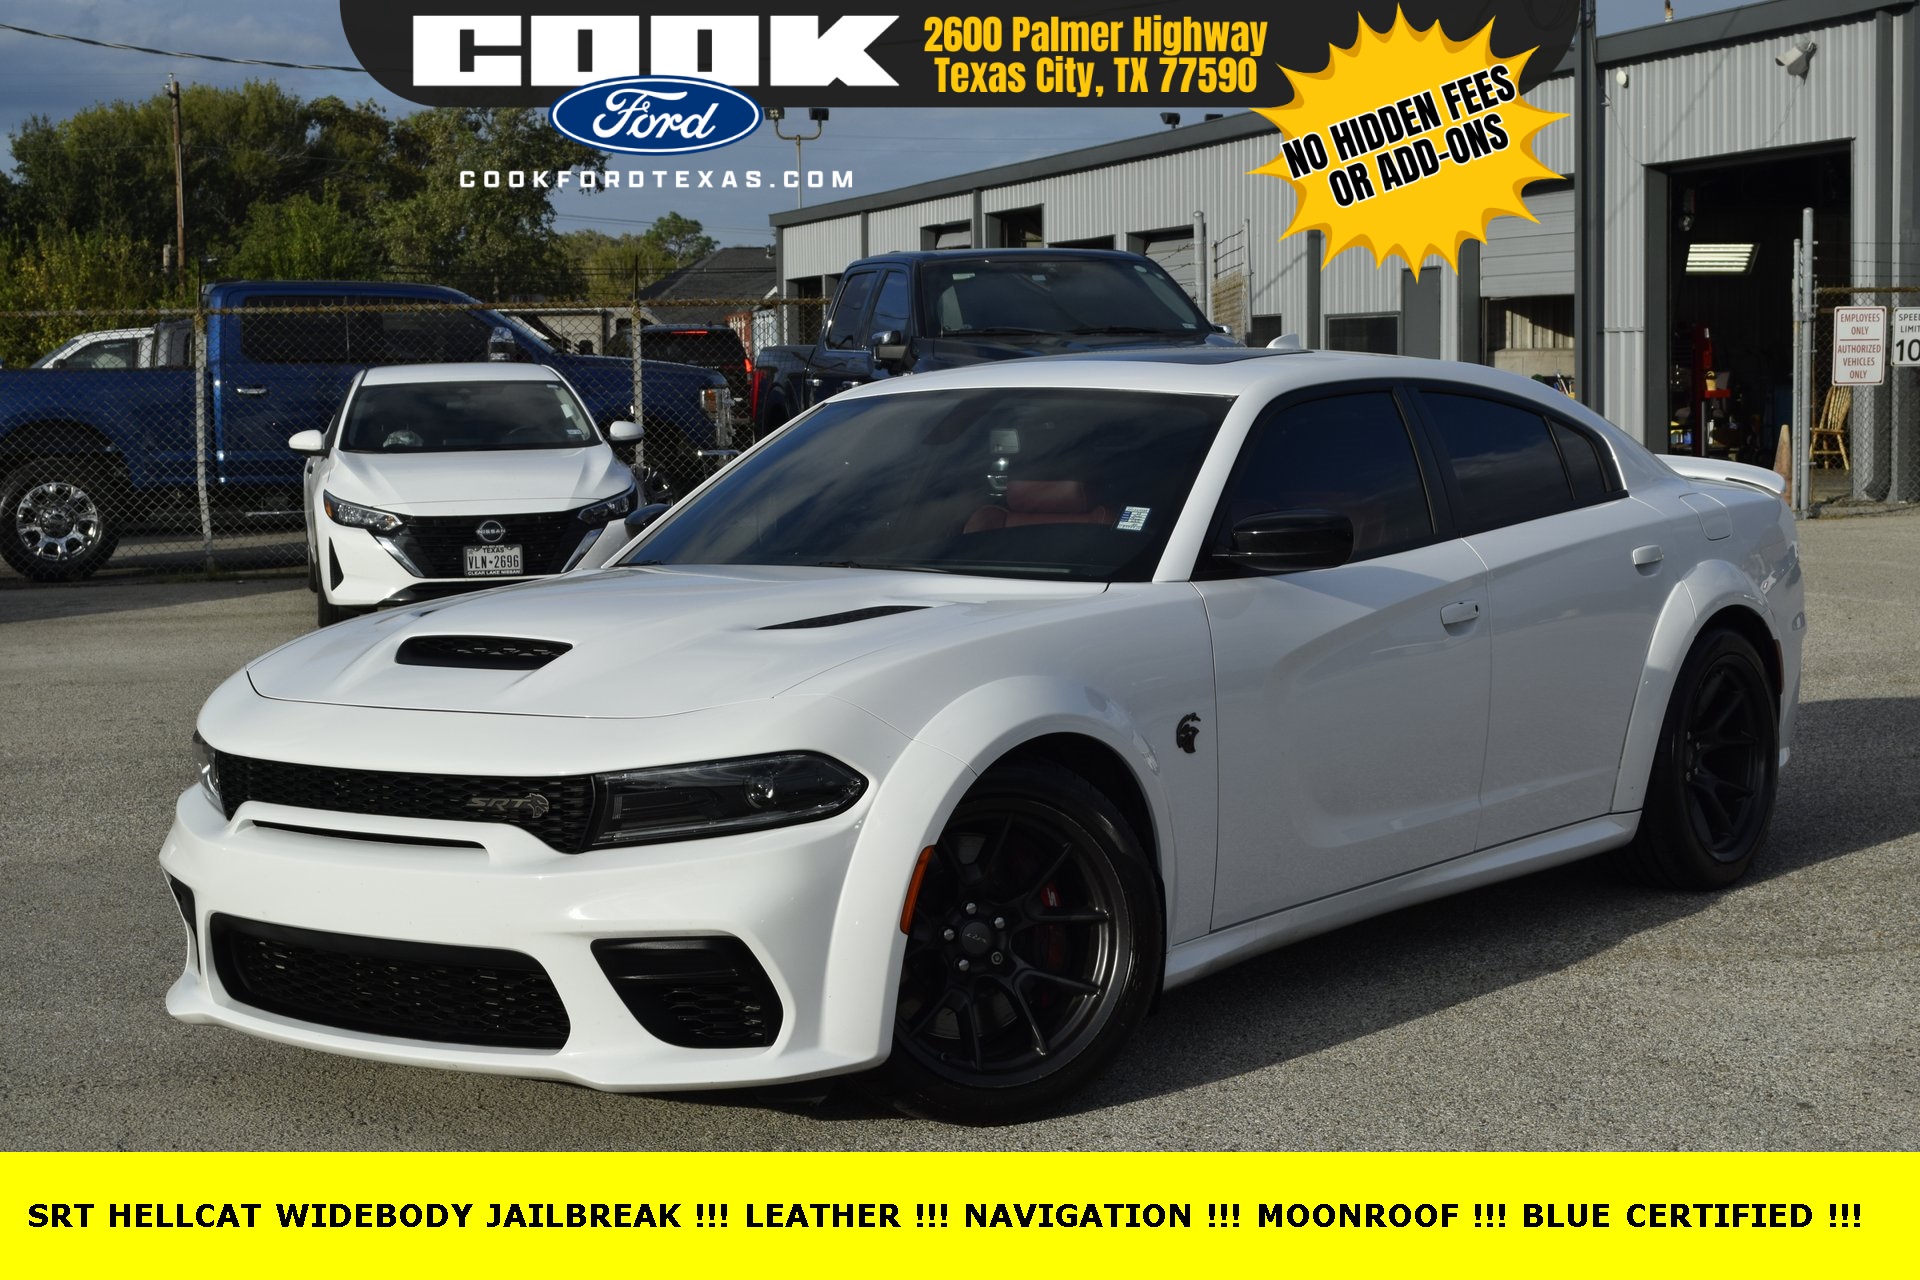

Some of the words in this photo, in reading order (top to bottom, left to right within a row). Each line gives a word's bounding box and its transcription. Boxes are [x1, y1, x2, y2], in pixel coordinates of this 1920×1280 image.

[1840, 313, 1880, 322] EMPLOYEES
[1898, 313, 1920, 322] SPEE
[1850, 326, 1870, 335] ONLY
[1837, 344, 1881, 354] AUTHORIZED
[1895, 338, 1920, 362] 10
[1842, 357, 1875, 367] VEHICLES
[1849, 370, 1868, 379] ONLY
[466, 797, 531, 811] SRT
